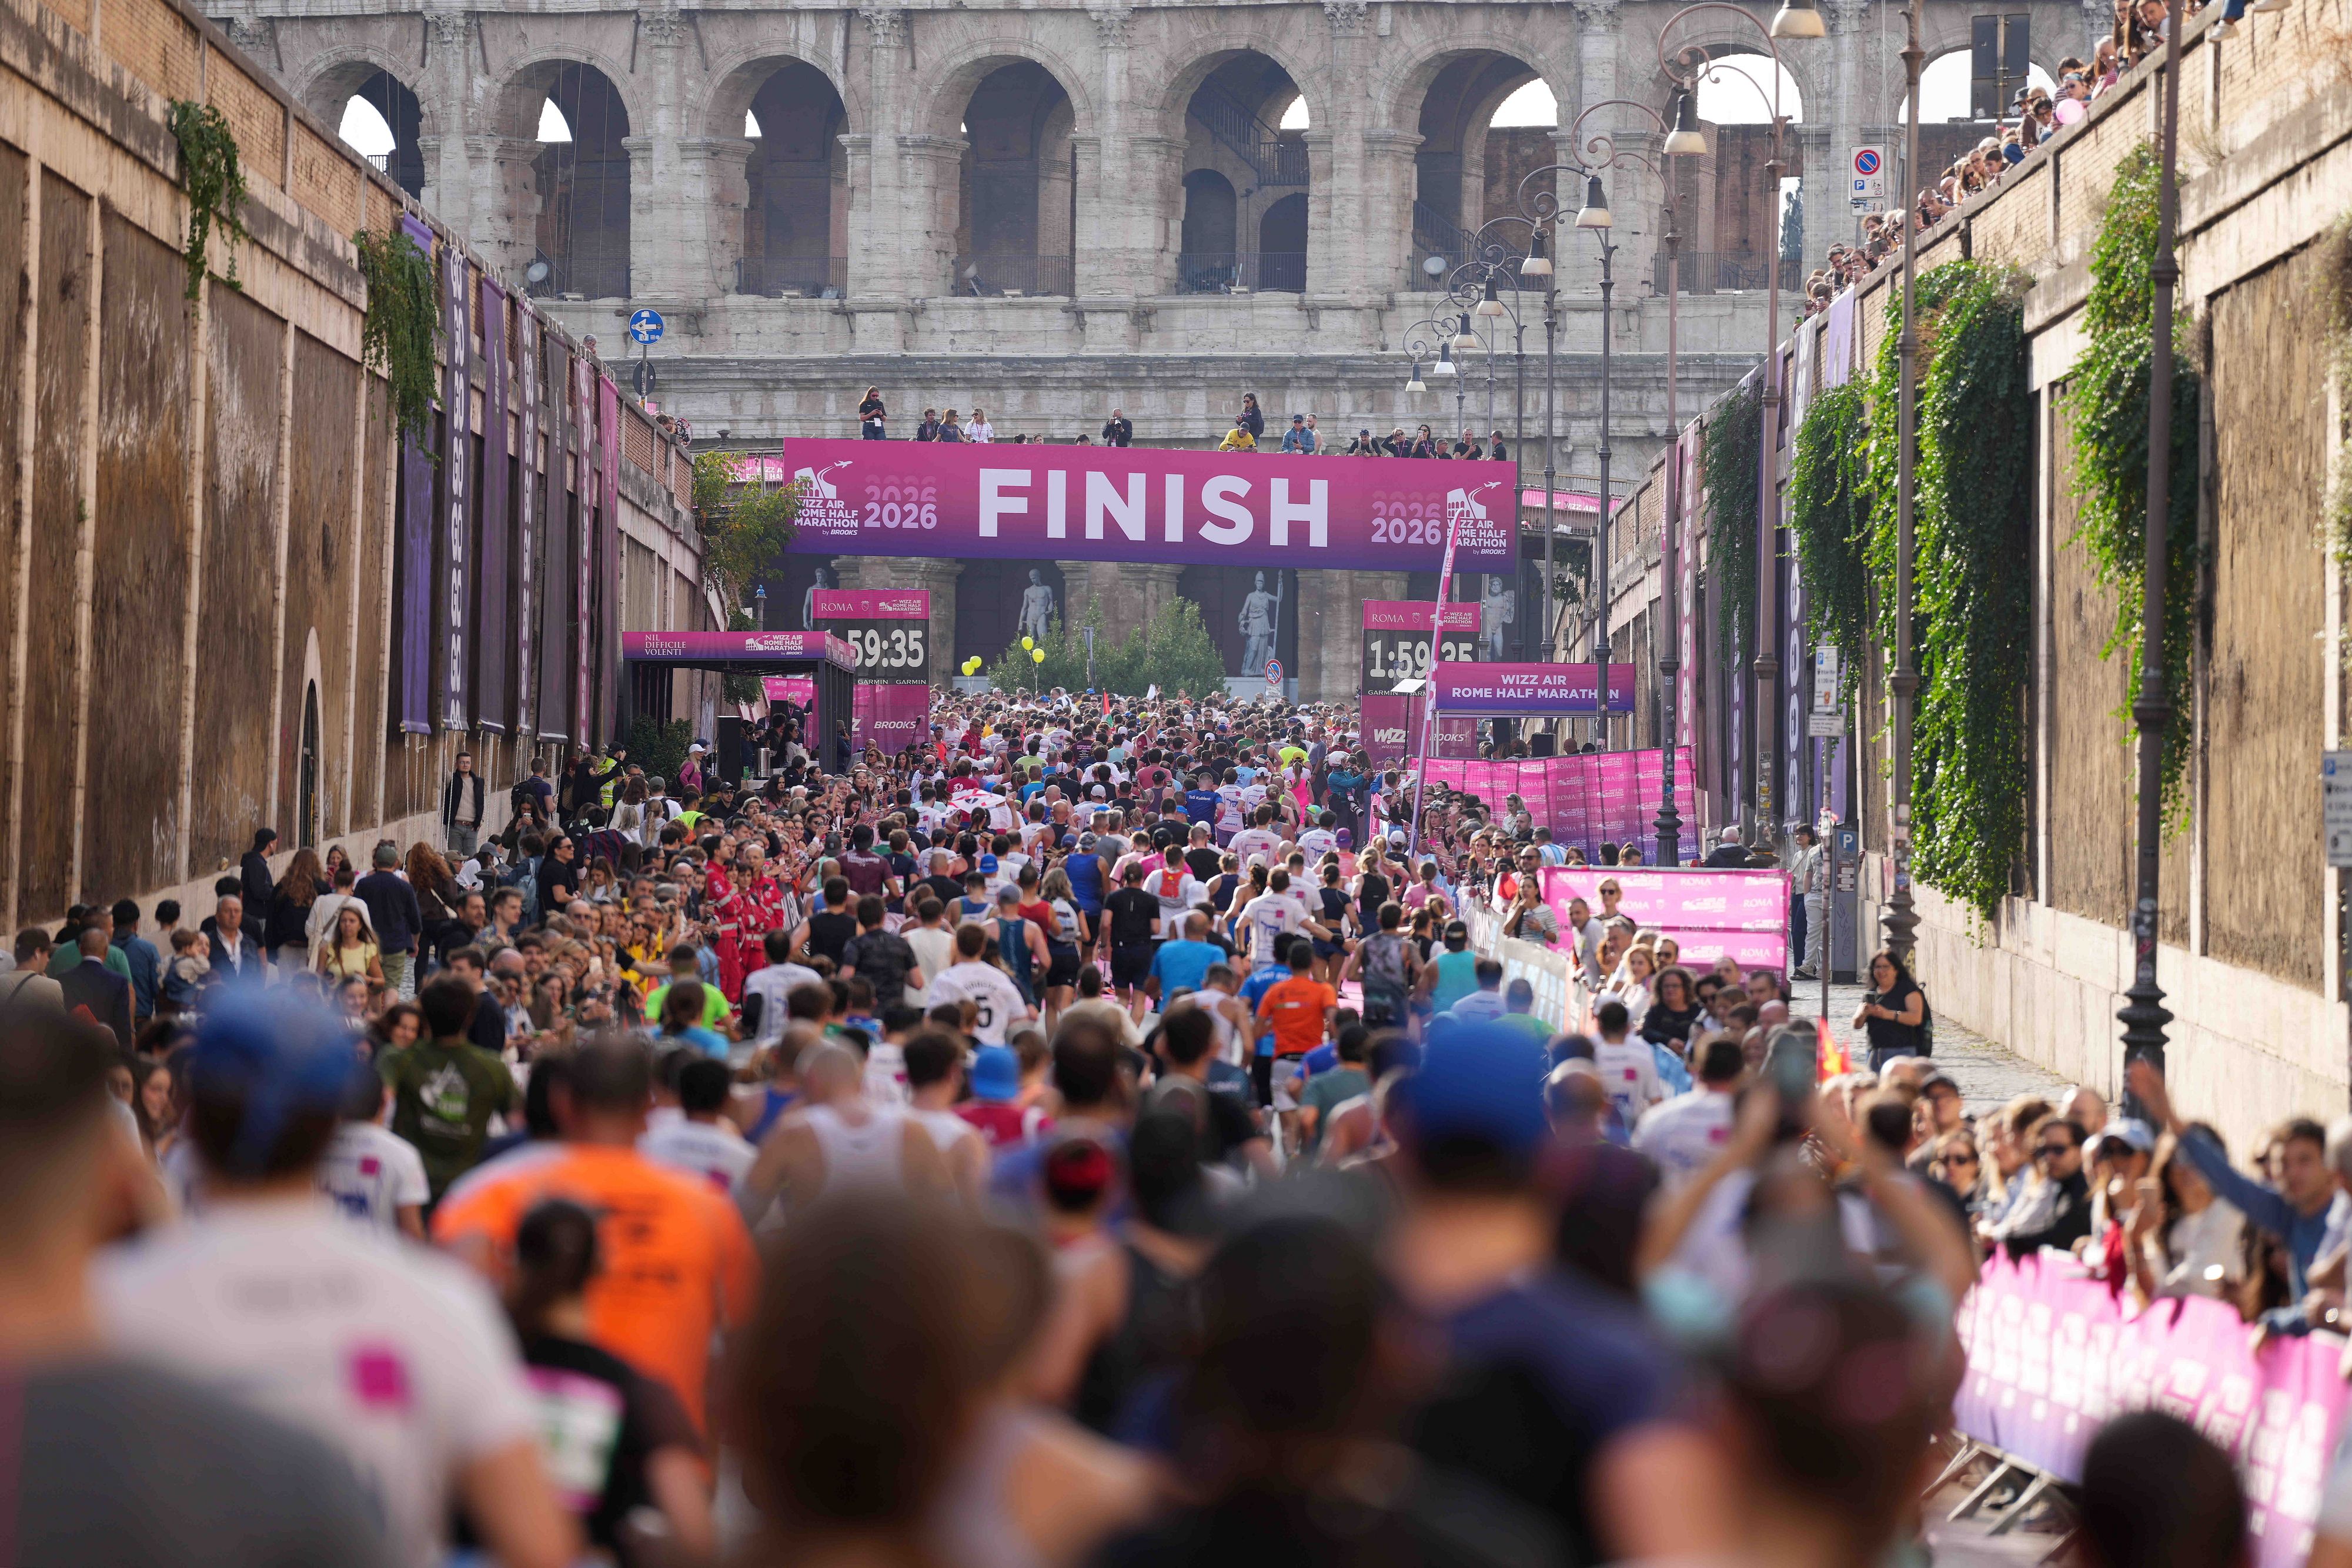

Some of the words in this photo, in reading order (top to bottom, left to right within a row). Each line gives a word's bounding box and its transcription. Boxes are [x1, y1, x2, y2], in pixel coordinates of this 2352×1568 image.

[454, 305, 465, 367] GO
[454, 370, 465, 432] GO
[453, 436, 463, 497] GO
[826, 500, 844, 509] AIR
[829, 510, 858, 519] HALF
[864, 502, 937, 529] 2026
[979, 468, 1328, 547] FINISH
[451, 502, 462, 563] GO
[794, 518, 858, 527] MARATHON
[1371, 517, 1441, 544] 2026
[1476, 520, 1494, 529] AIR
[1479, 530, 1506, 538] HALF
[1447, 537, 1506, 547] ARATHON
[451, 568, 462, 628] GO
[848, 629, 924, 667] 59:35
[450, 633, 461, 693] GO
[1452, 687, 1492, 698] ROME
[1496, 688, 1533, 698] HALF
[1538, 688, 1619, 699] MARATHN
[1501, 674, 1538, 684] WIZZ
[1542, 675, 1566, 685] AIR
[1843, 834, 1853, 848] P
